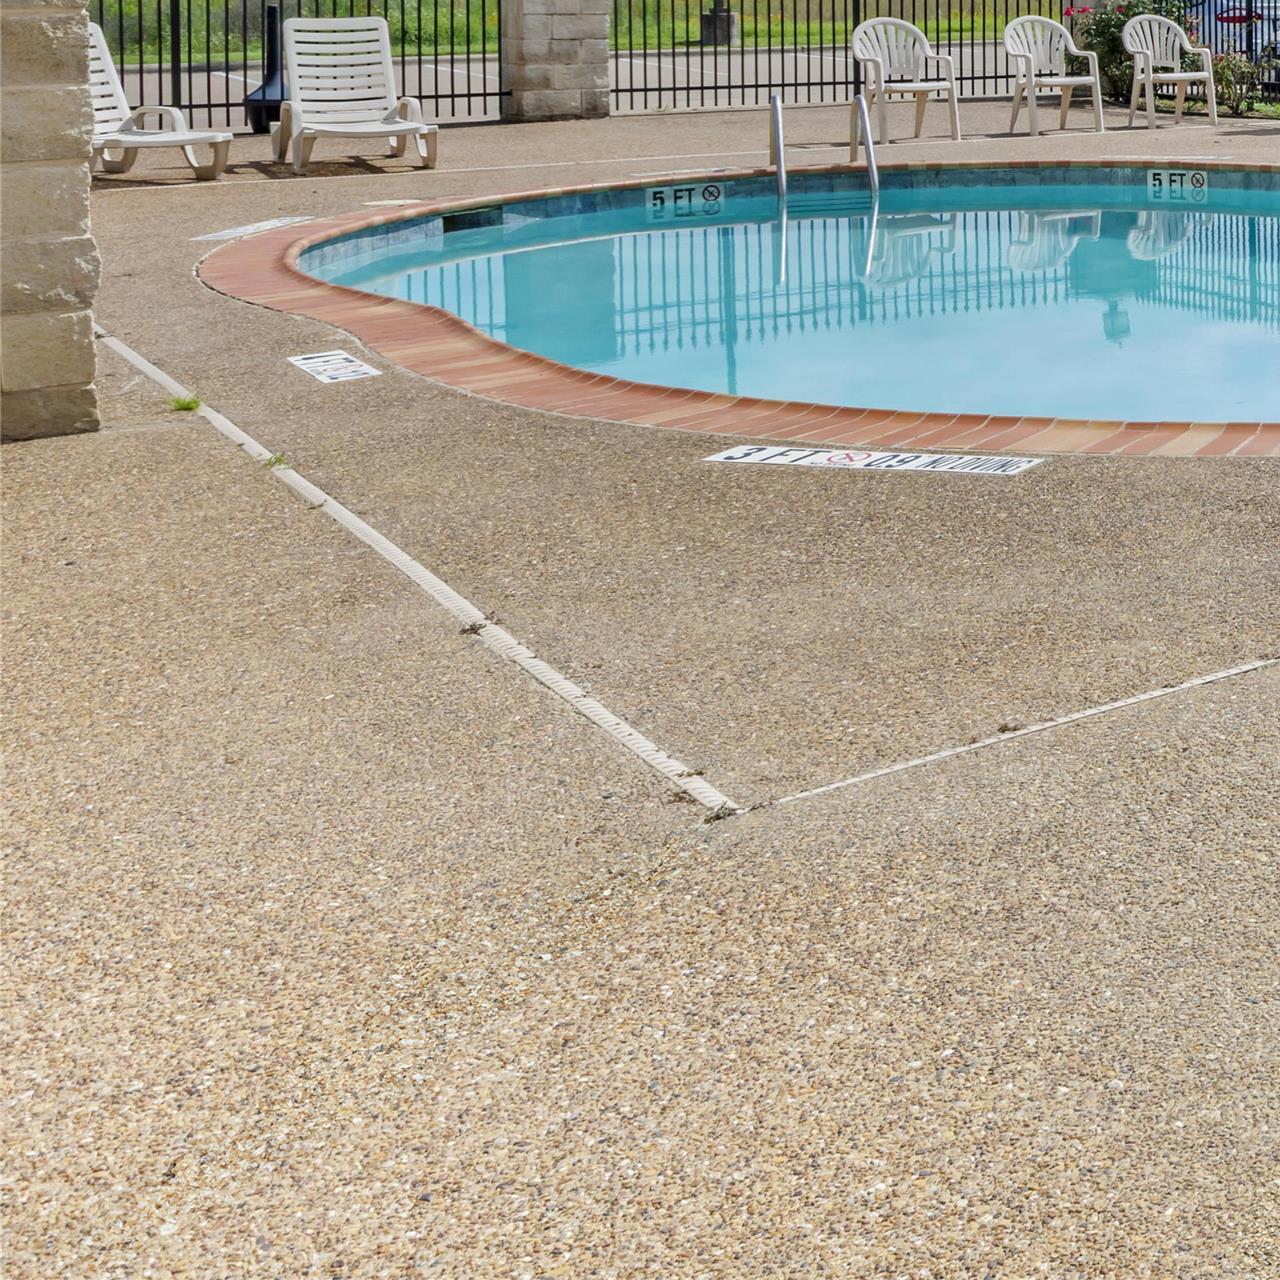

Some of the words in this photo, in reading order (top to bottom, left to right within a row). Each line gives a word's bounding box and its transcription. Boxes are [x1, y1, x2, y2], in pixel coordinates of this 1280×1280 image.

[1152, 172, 1162, 187] 5
[1169, 172, 1186, 187] FT
[652, 190, 665, 206] 5
[673, 187, 696, 205] FT
[723, 447, 768, 460] 3
[758, 448, 832, 463] FT
[863, 454, 922, 468] 0.9
[915, 455, 964, 470] NO
[949, 457, 1033, 473] DIVING
